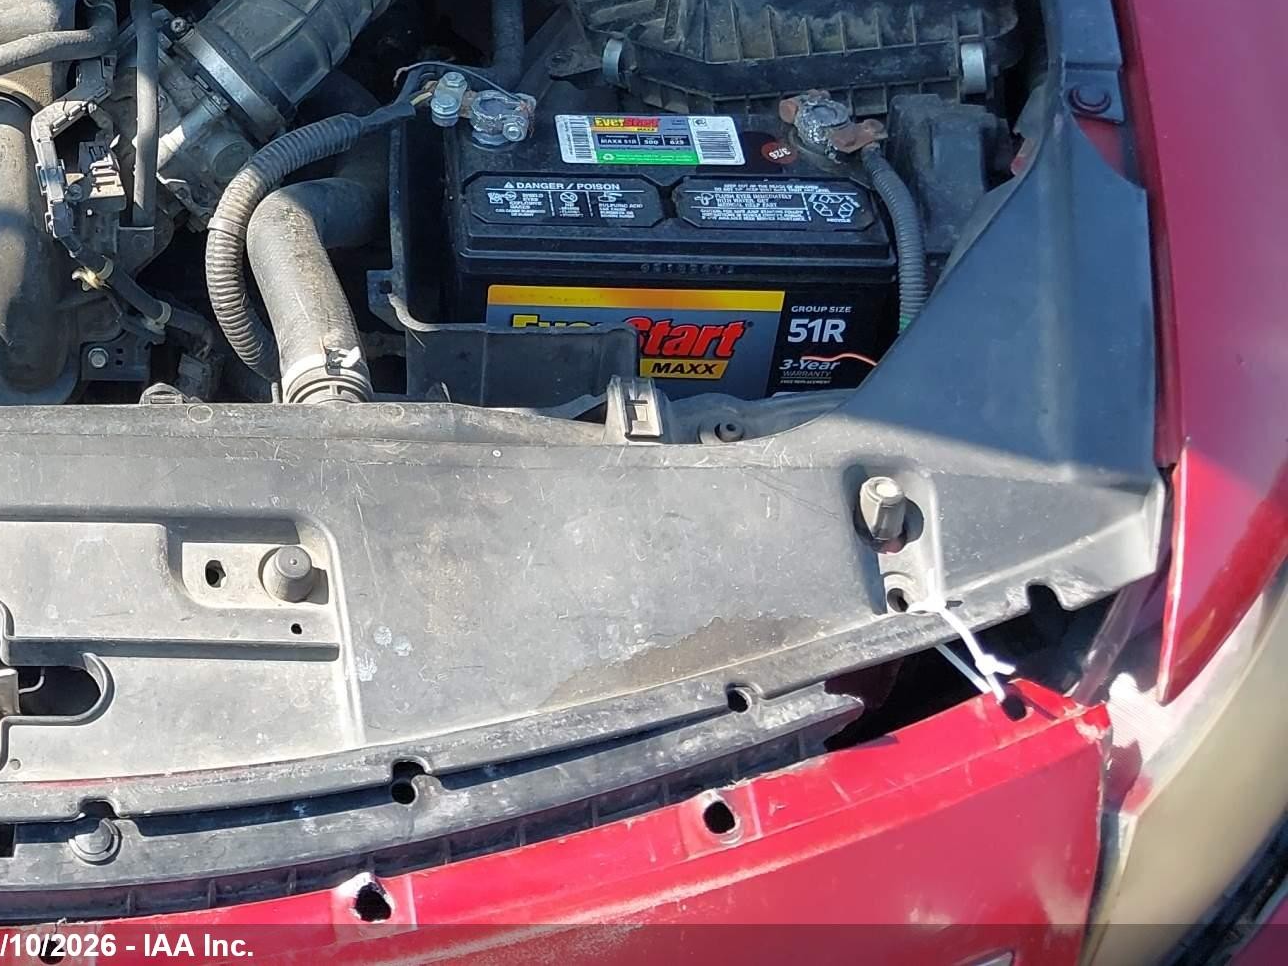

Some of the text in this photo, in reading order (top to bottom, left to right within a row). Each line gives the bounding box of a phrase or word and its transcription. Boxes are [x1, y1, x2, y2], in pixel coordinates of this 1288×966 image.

[516, 182, 564, 190] DANGER
[791, 305, 827, 313] GROUP
[787, 318, 847, 343] 51R
[650, 362, 718, 375] MAXX
[779, 358, 841, 370] 3-Year
